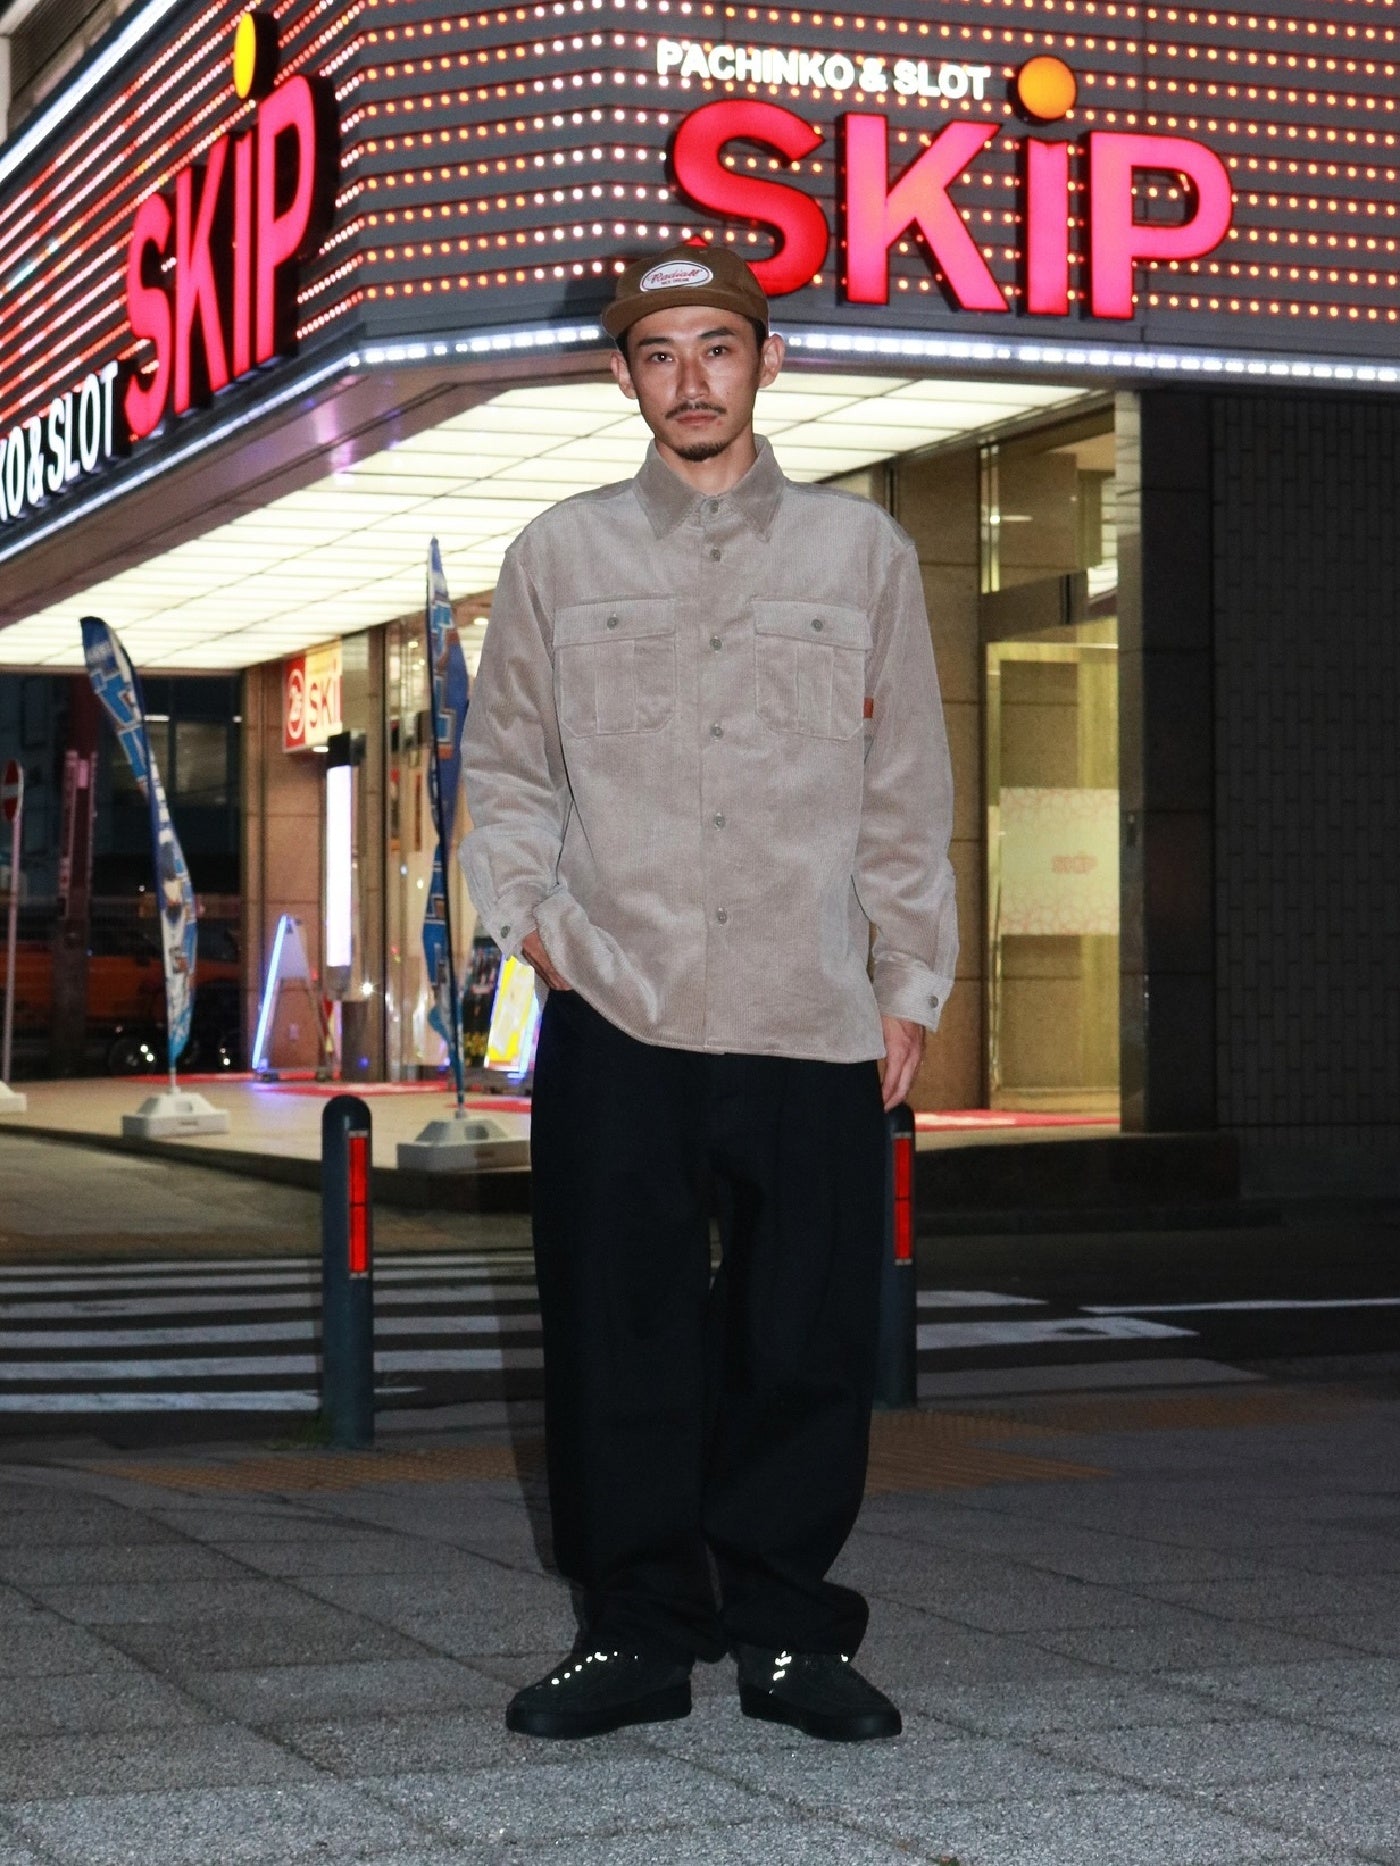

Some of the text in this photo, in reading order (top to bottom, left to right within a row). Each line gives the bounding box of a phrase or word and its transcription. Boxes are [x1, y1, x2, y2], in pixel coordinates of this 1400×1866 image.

[656, 38, 991, 100] PACHINKO & SLOT
[27, 415, 44, 504] &
[47, 360, 118, 492] SLOT
